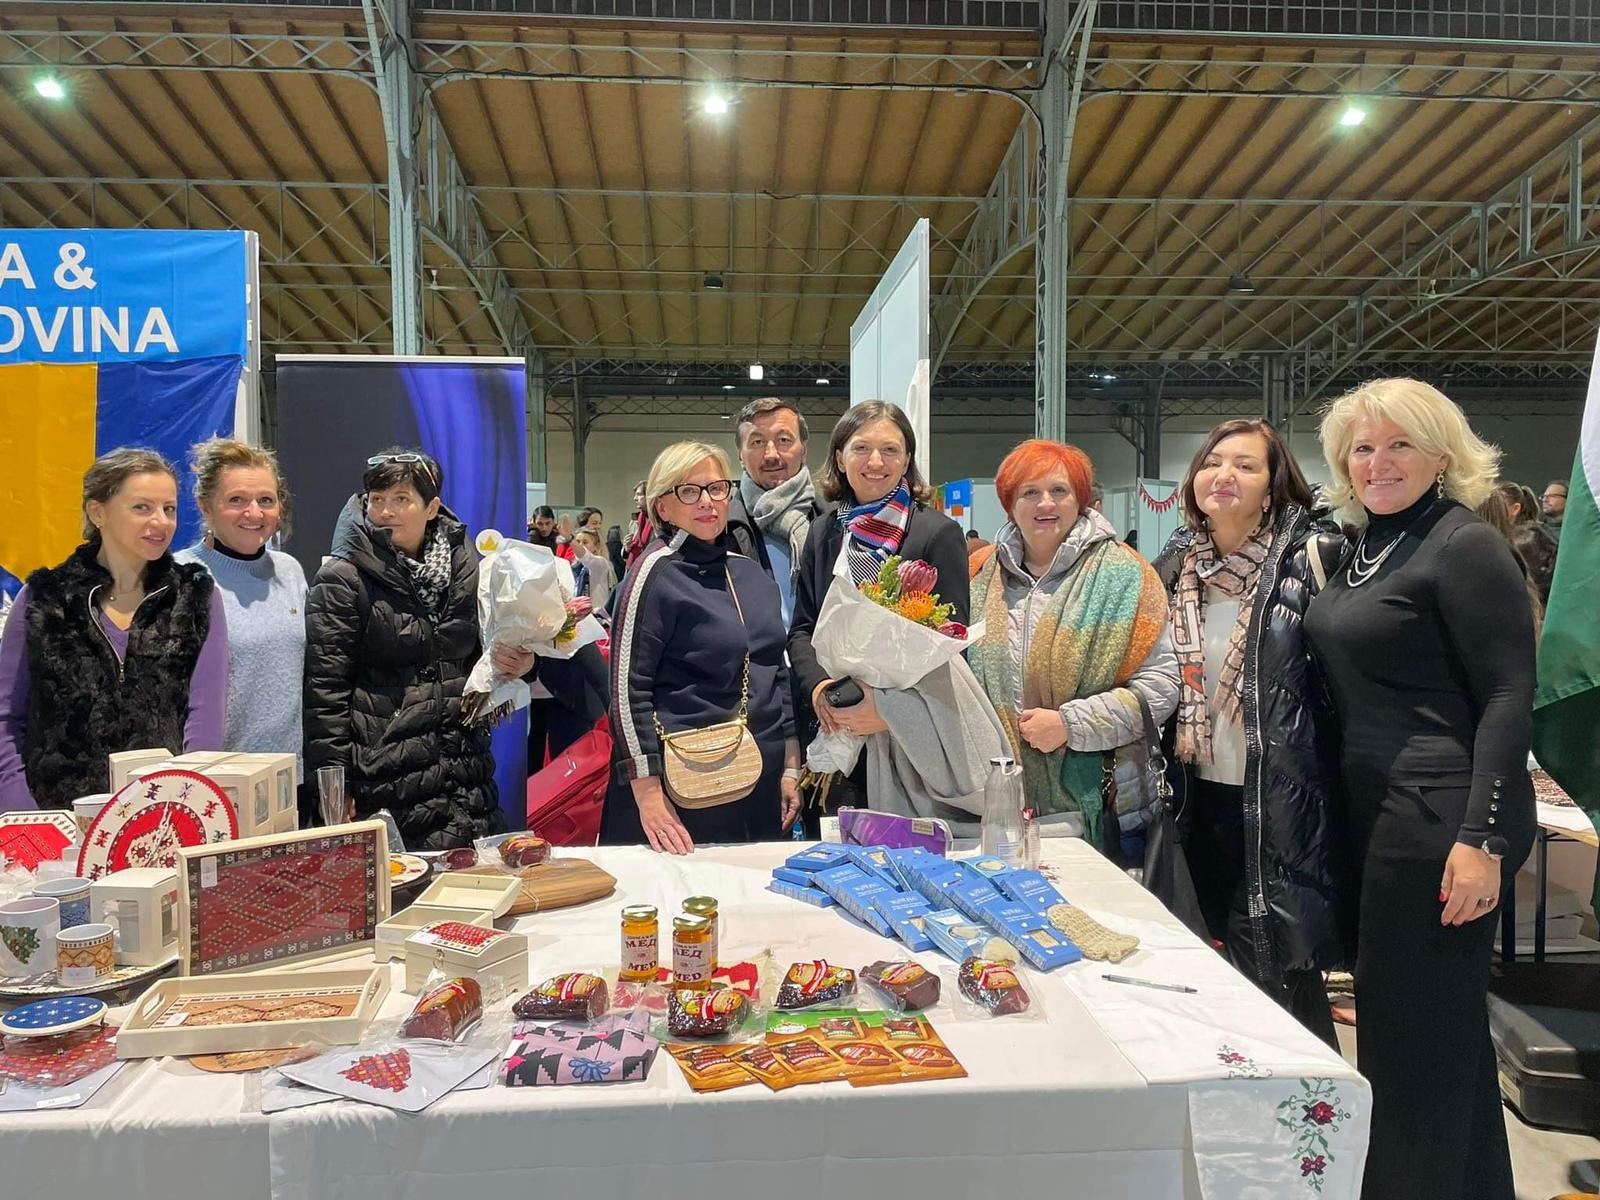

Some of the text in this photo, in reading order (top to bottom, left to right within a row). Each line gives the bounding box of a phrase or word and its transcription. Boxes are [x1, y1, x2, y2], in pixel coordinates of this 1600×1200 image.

[0, 242, 97, 290] A &
[625, 938, 657, 948] МЕД
